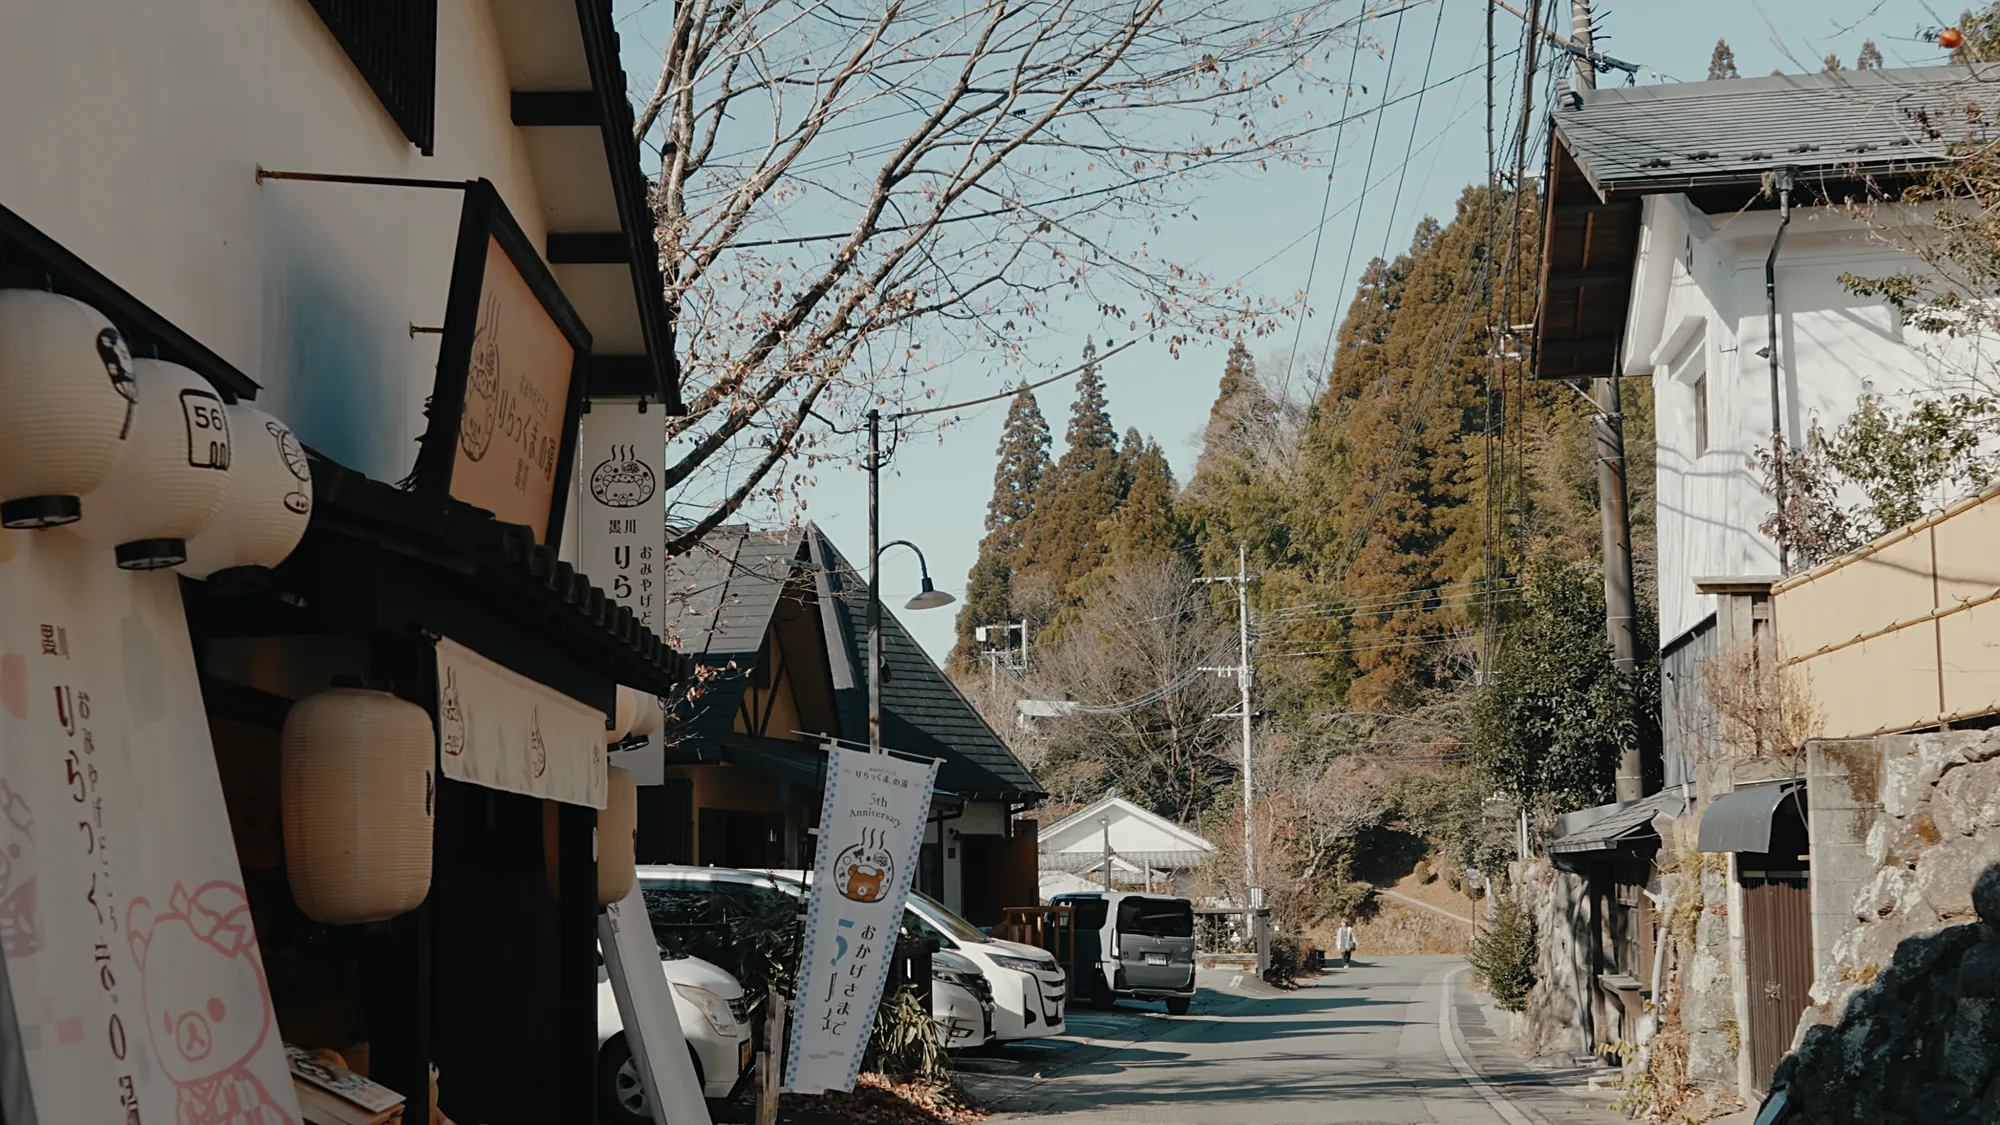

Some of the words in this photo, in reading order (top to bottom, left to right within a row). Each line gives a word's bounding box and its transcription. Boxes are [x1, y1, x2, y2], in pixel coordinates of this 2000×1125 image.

[193, 405, 223, 431] 56
[608, 519, 637, 535] 黒川
[869, 792, 888, 808] 5th
[849, 807, 903, 829] Anniversary
[832, 925, 877, 1036] おかげさまで
